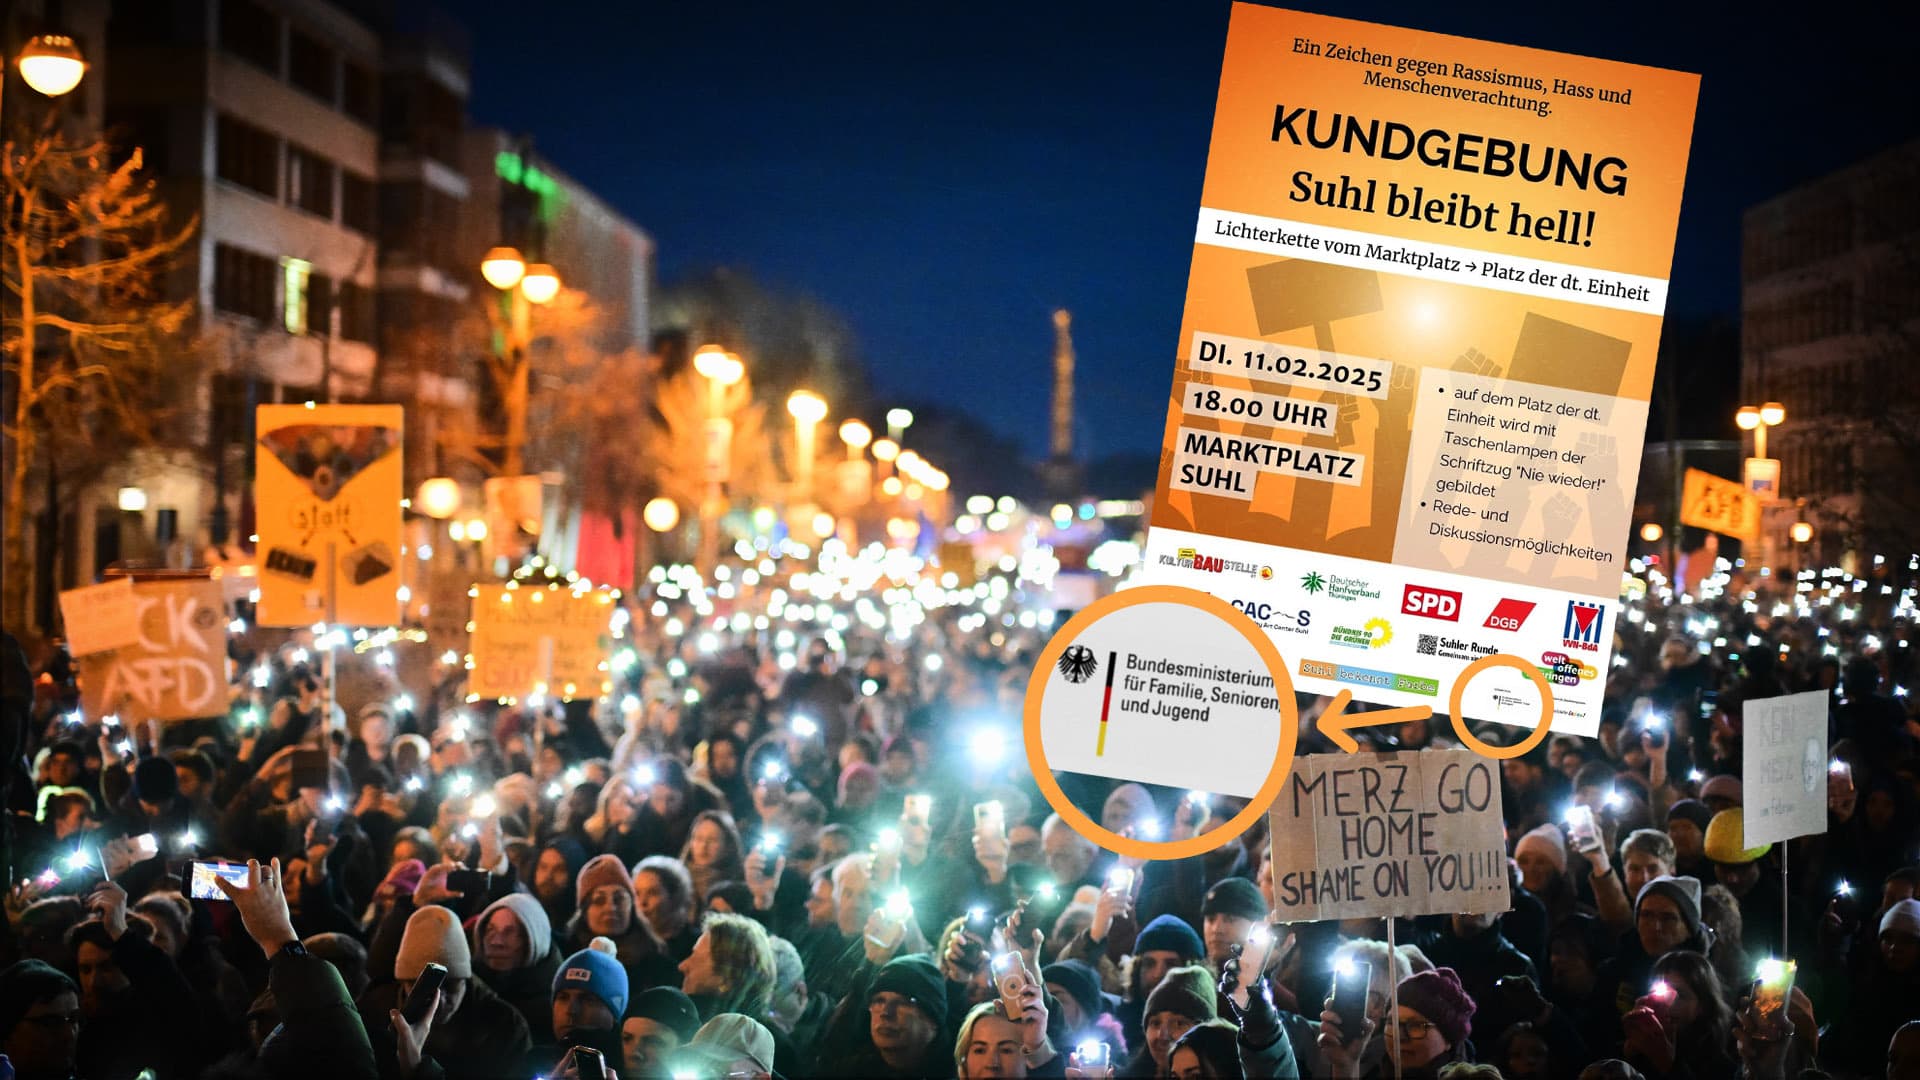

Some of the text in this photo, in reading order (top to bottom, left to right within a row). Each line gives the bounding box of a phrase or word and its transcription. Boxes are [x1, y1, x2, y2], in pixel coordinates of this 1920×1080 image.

[1292, 763, 1492, 818] MERZ GO
[1340, 812, 1440, 861] HOME
[1280, 850, 1502, 907] SHAME ON YOU!!!
